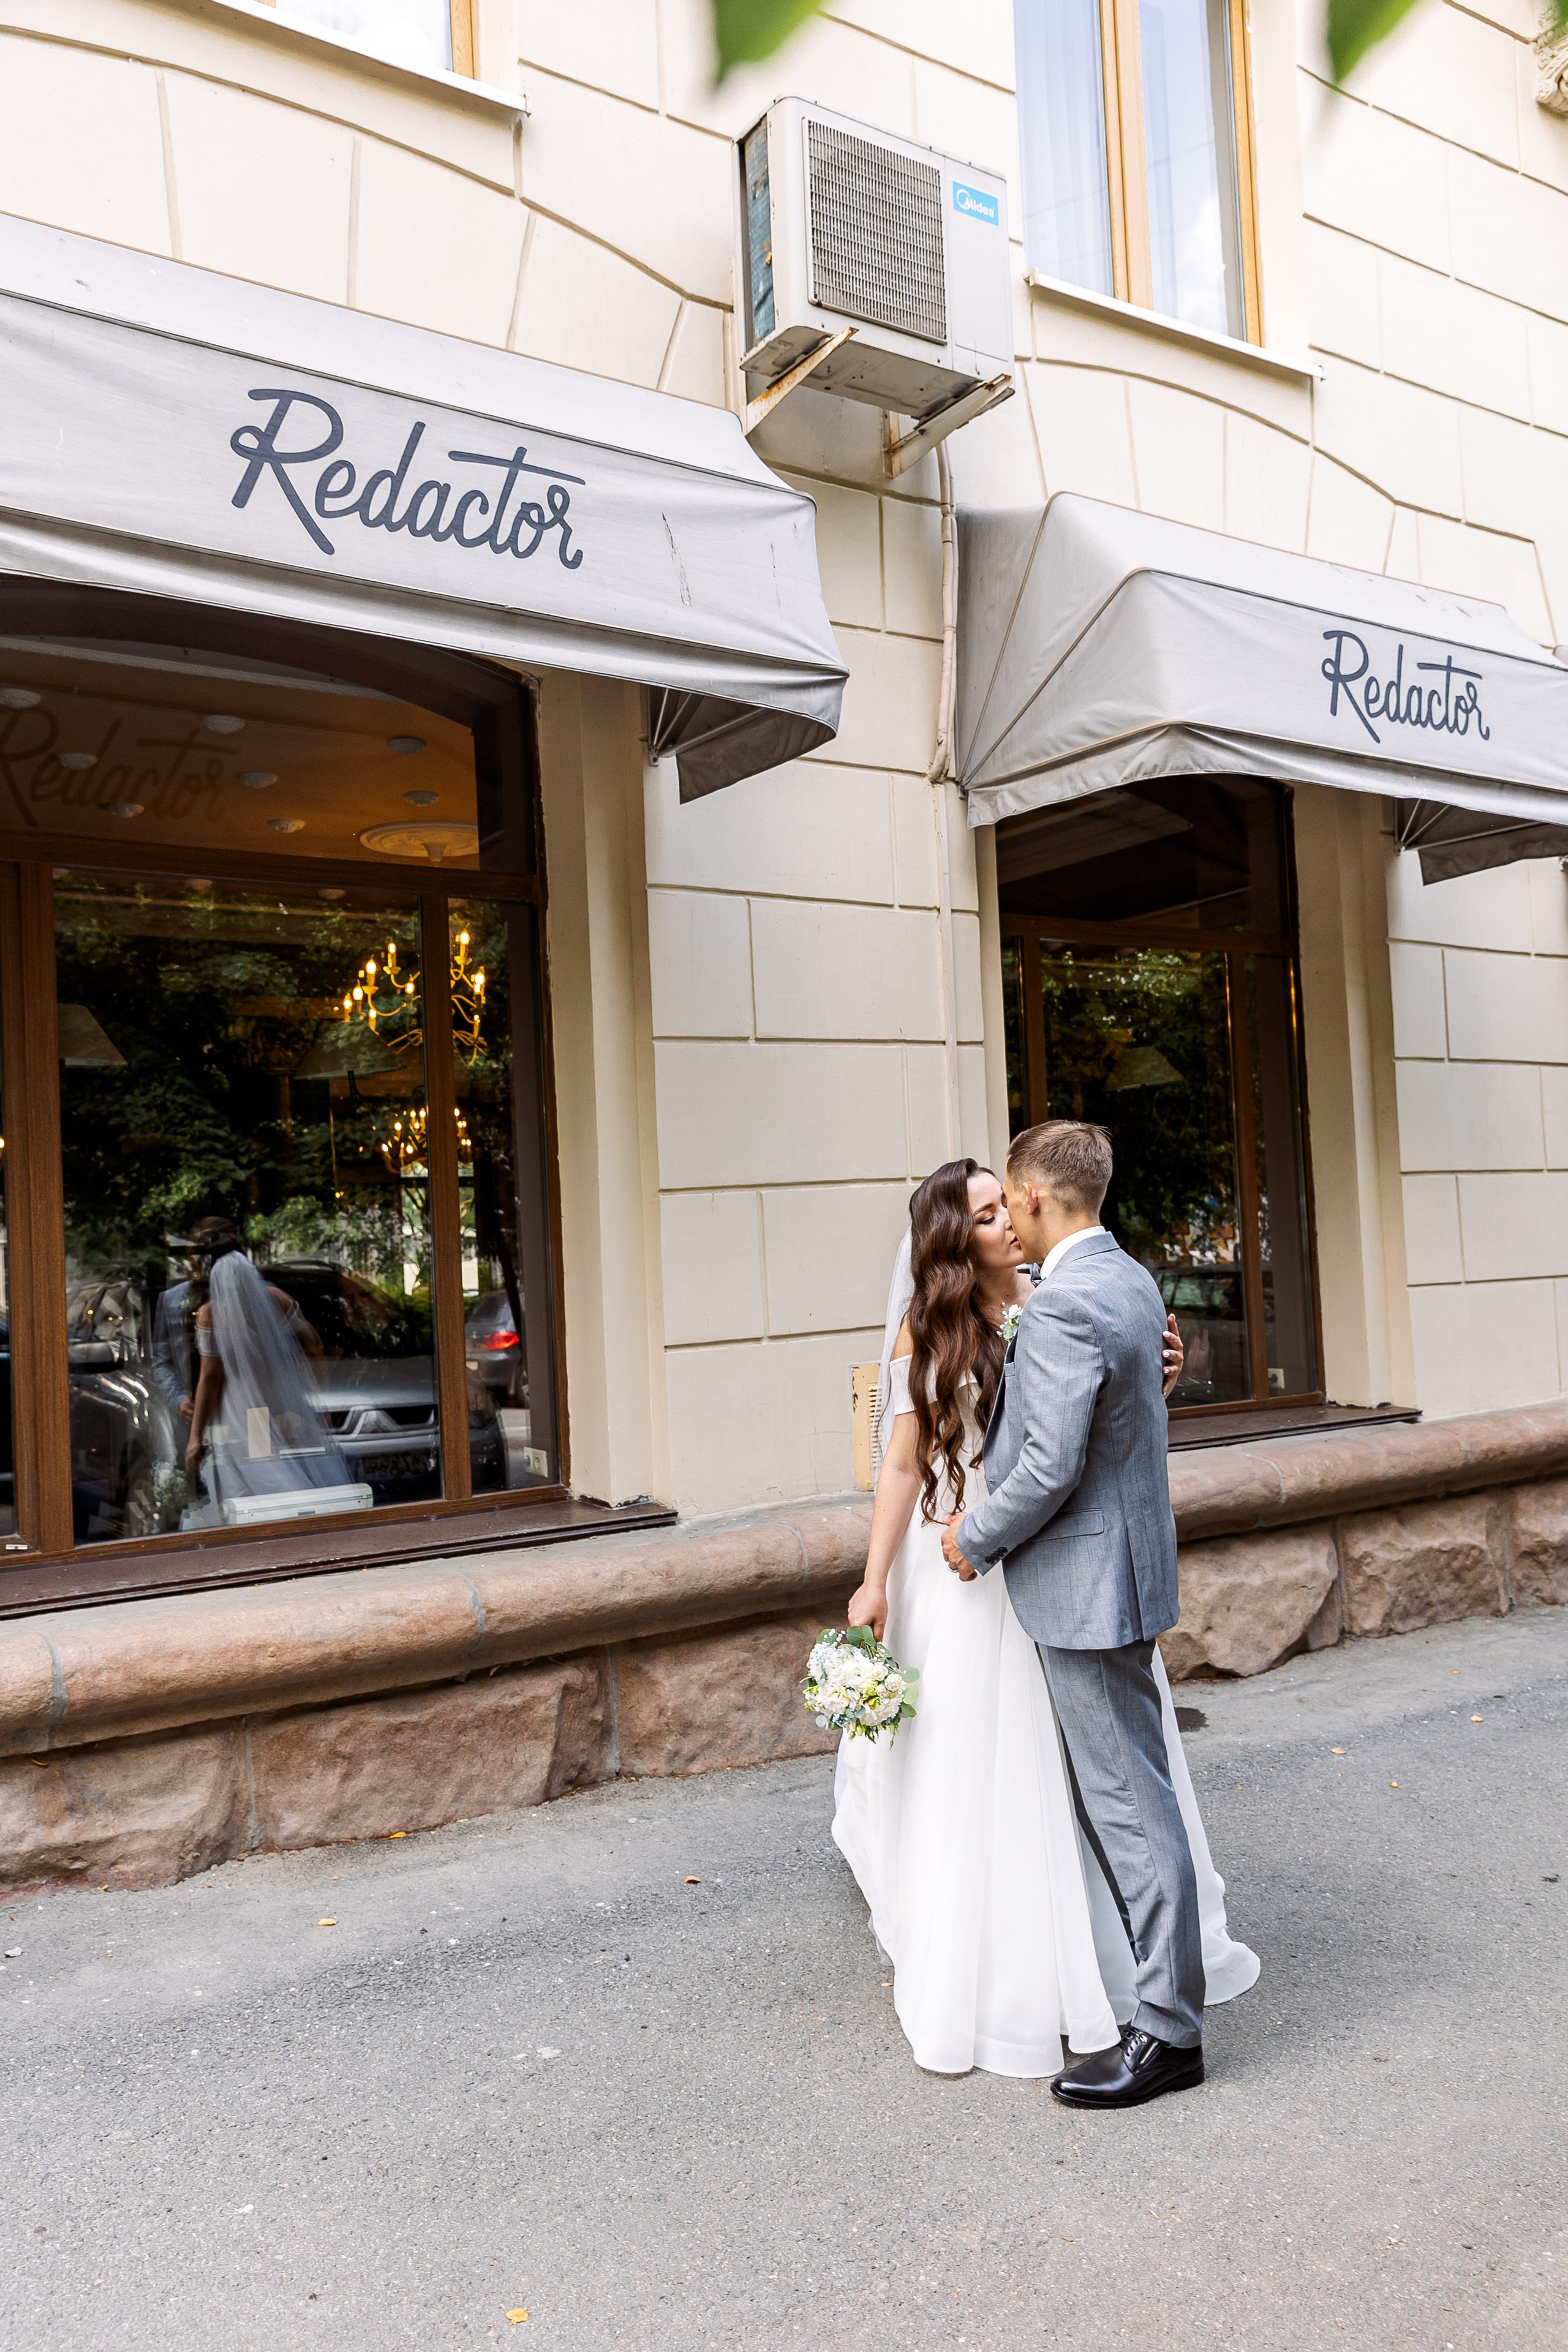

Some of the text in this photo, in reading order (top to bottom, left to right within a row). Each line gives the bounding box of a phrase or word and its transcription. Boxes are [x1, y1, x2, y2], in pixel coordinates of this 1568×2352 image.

[956, 189, 995, 219] Midea
[230, 389, 586, 569] Redactor
[1322, 630, 1490, 744] Redactor
